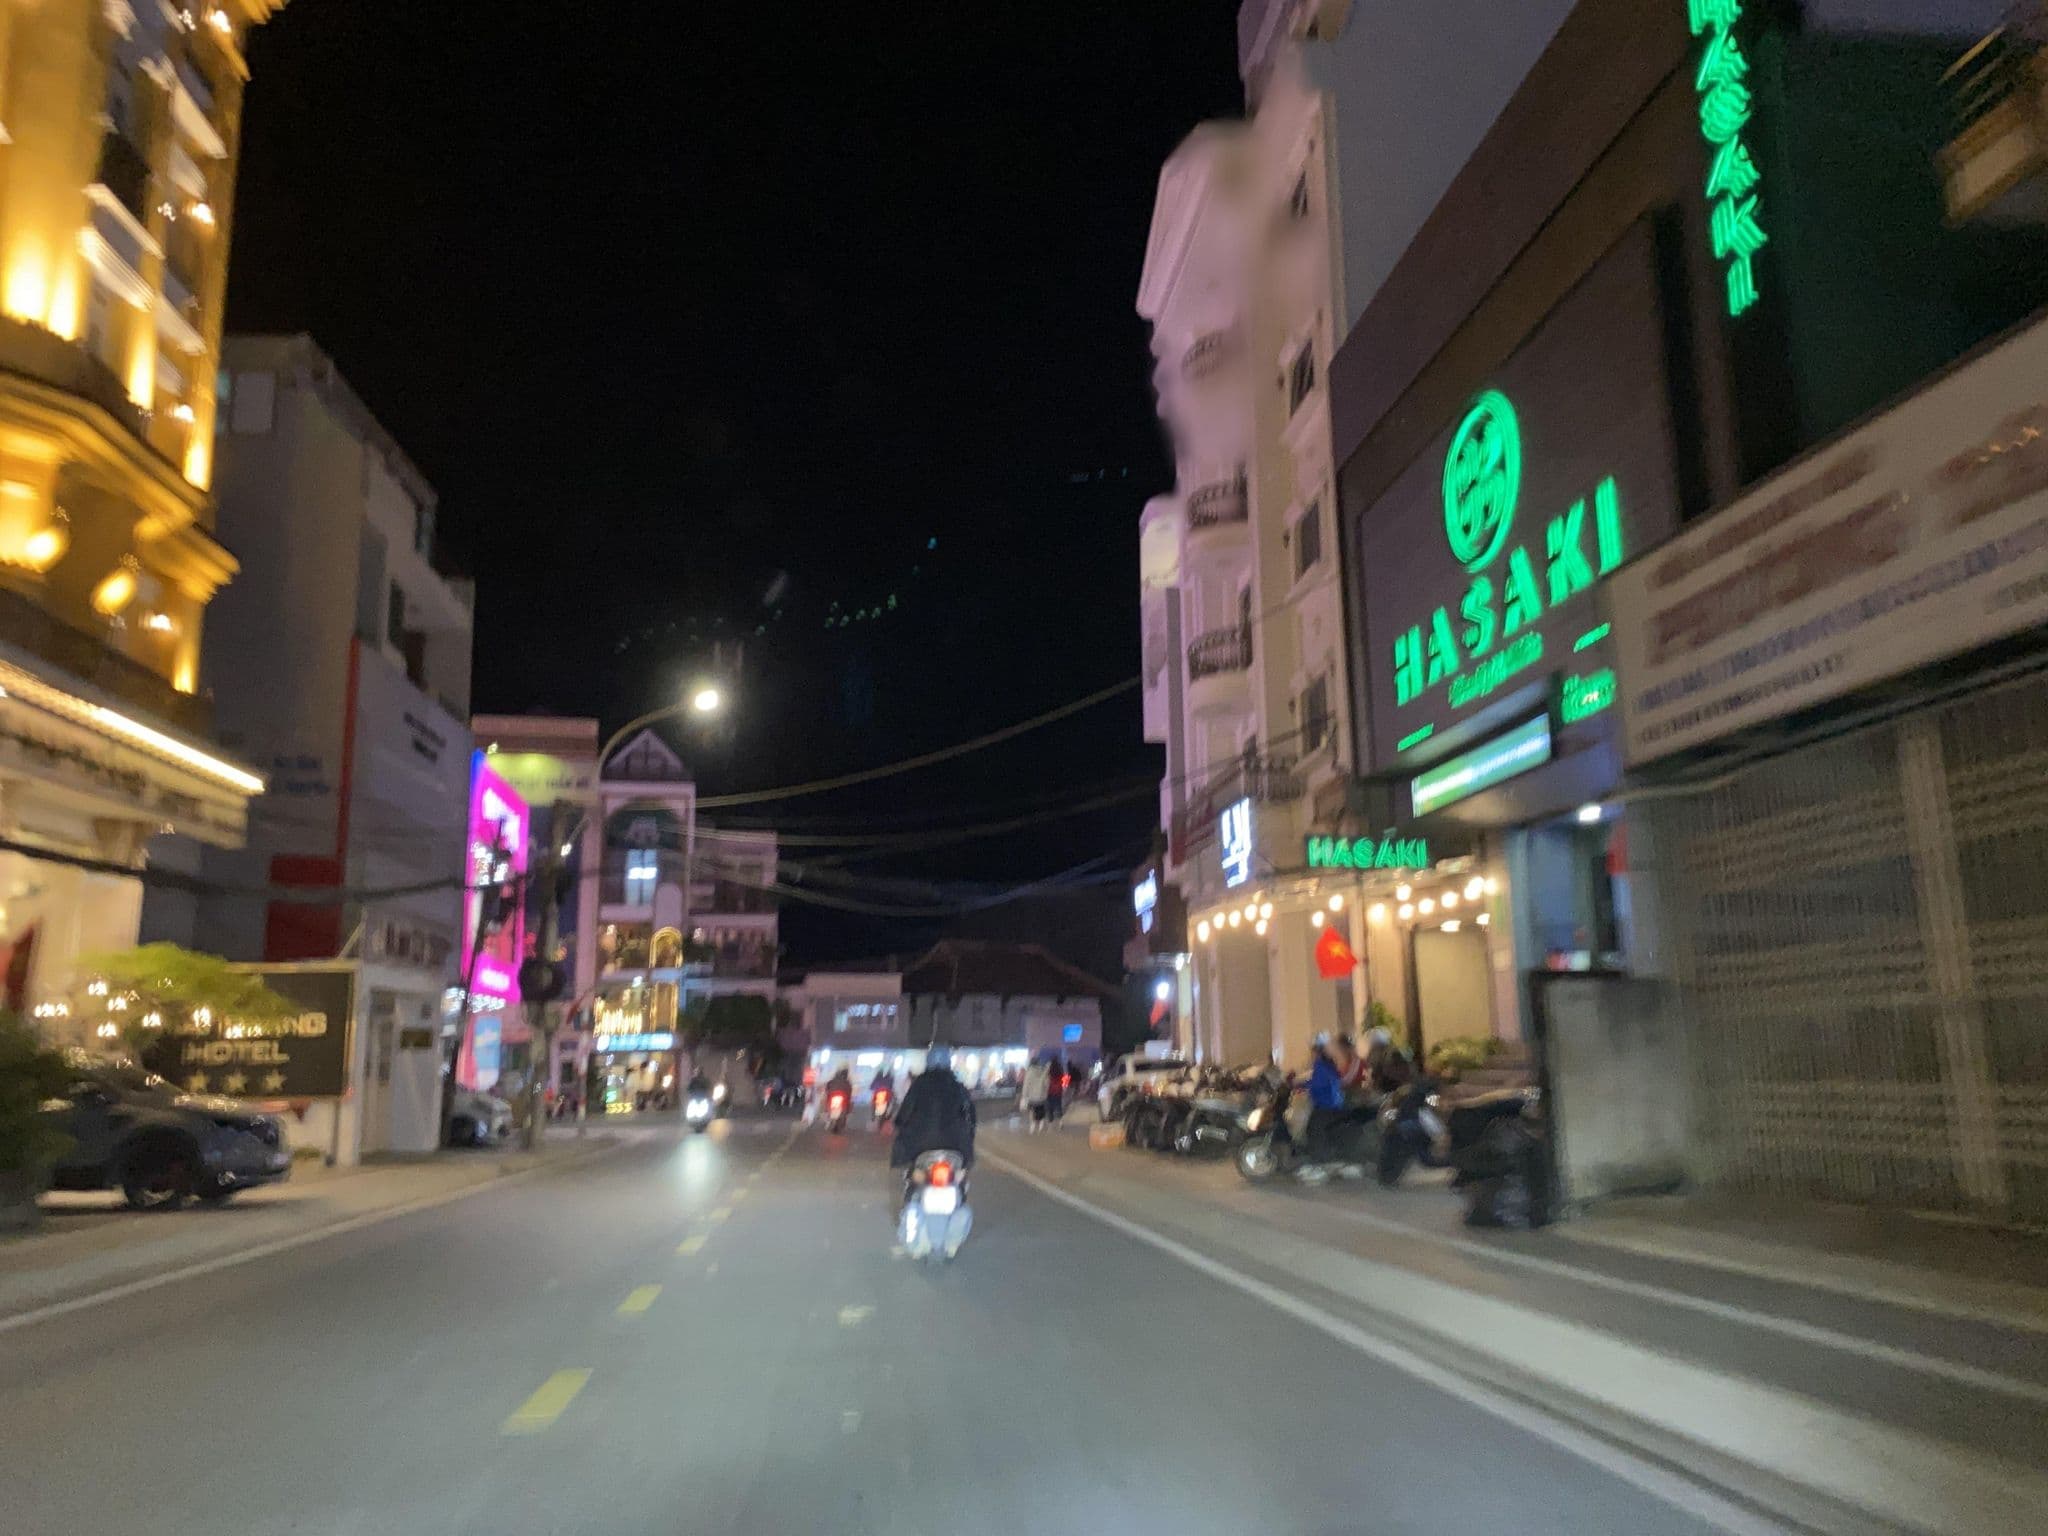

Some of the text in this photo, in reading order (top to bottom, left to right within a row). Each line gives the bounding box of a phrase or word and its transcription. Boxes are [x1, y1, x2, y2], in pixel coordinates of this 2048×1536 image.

[1393, 476, 1624, 707] HASAKI
[1307, 836, 1428, 869] HASAKI
[181, 1040, 290, 1067] HOTEL
